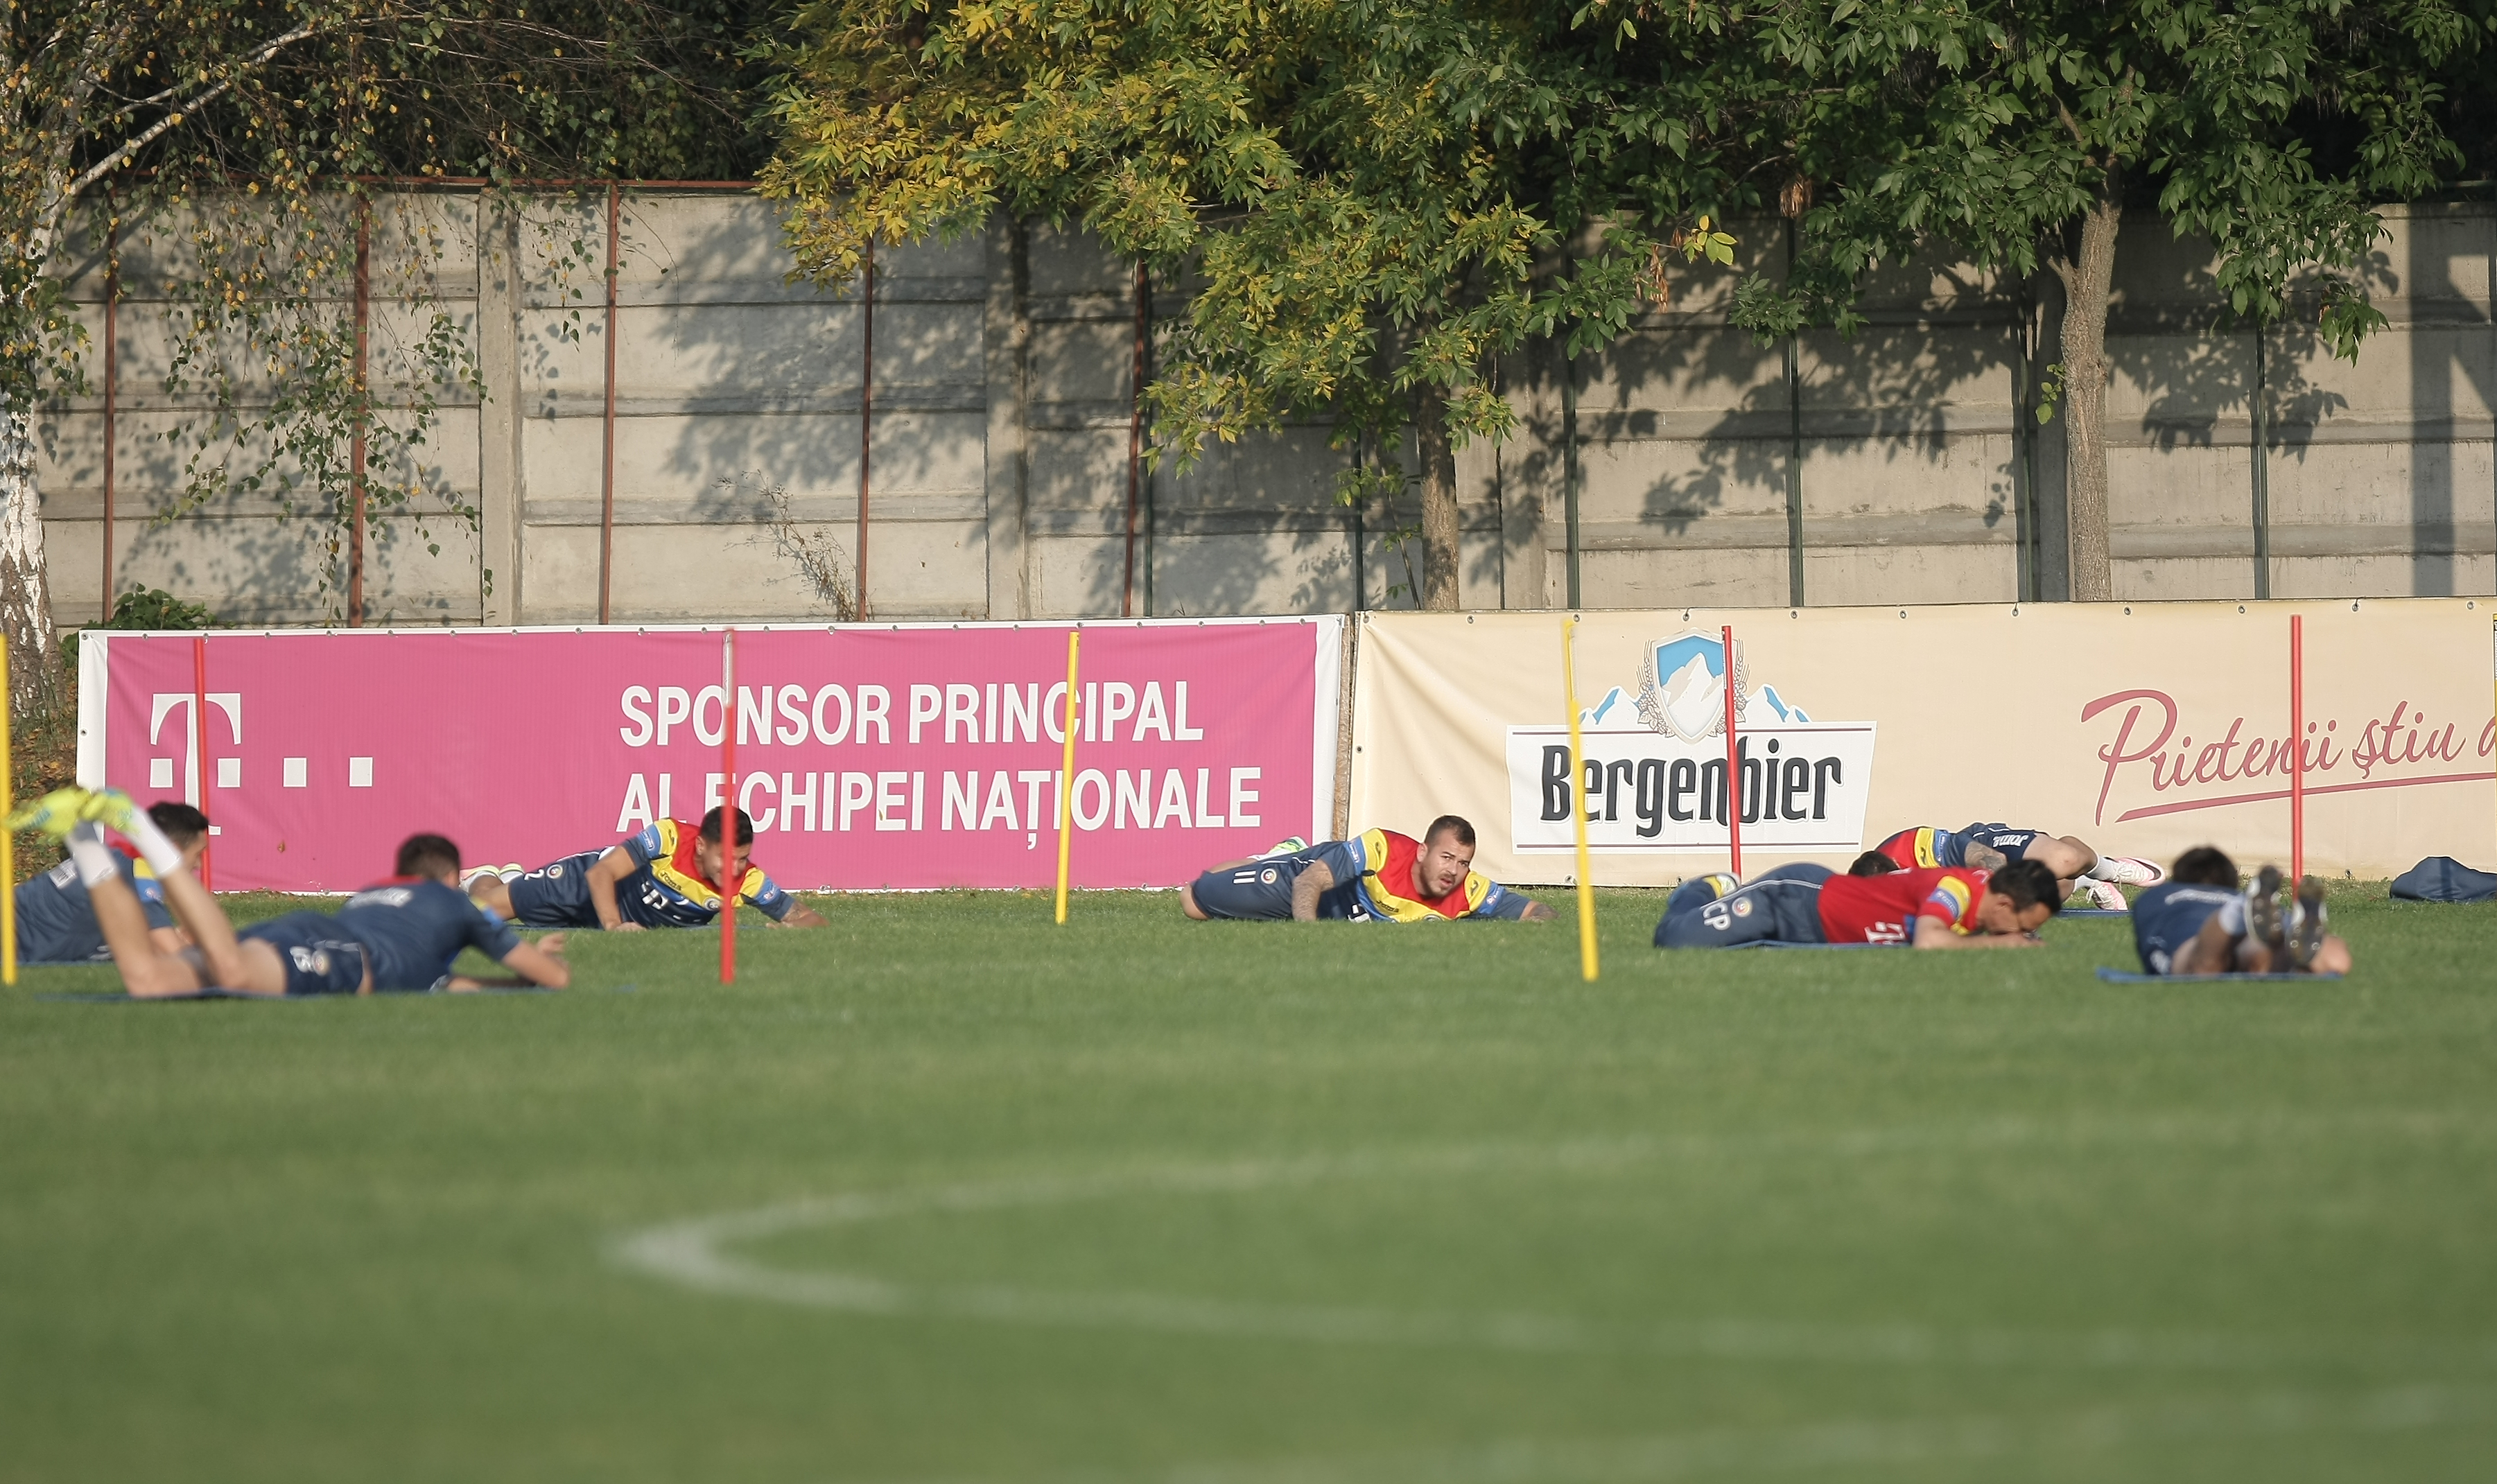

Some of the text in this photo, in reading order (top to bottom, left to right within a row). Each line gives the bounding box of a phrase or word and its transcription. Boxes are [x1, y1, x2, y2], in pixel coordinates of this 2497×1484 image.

[620, 681, 1203, 747] SPONSOR PRINCIPAL
[1540, 736, 1842, 837] Bergenbier
[2081, 689, 2344, 826] Prietenii
[616, 773, 688, 832] AL
[1233, 871, 1256, 884] 11
[1703, 902, 1731, 931] CP
